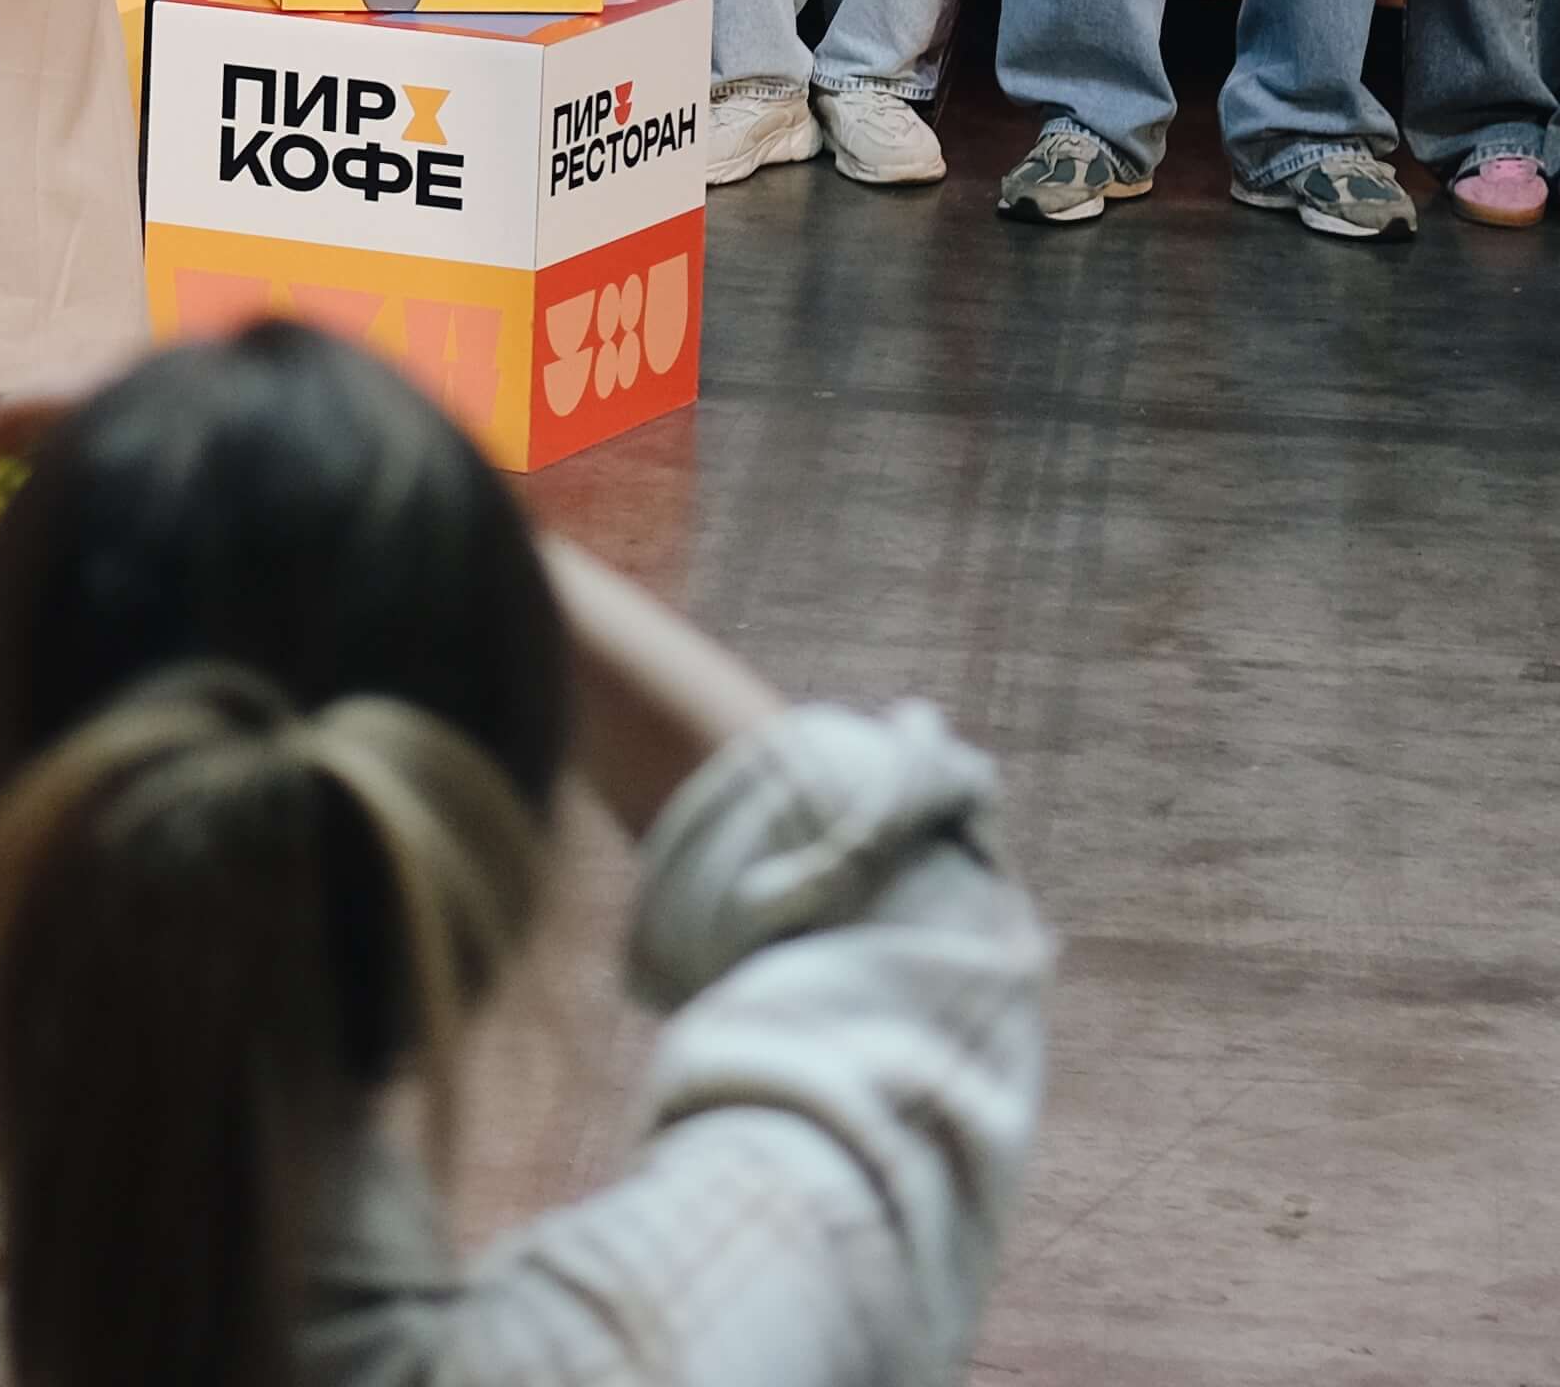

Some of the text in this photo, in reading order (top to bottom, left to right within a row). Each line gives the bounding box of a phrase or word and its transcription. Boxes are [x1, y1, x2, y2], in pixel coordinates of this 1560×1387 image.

[222, 64, 396, 135] ПИР
[552, 87, 613, 146] ПИР
[220, 129, 464, 211] КОФЕ
[551, 109, 696, 197] РЕСТОРАН
